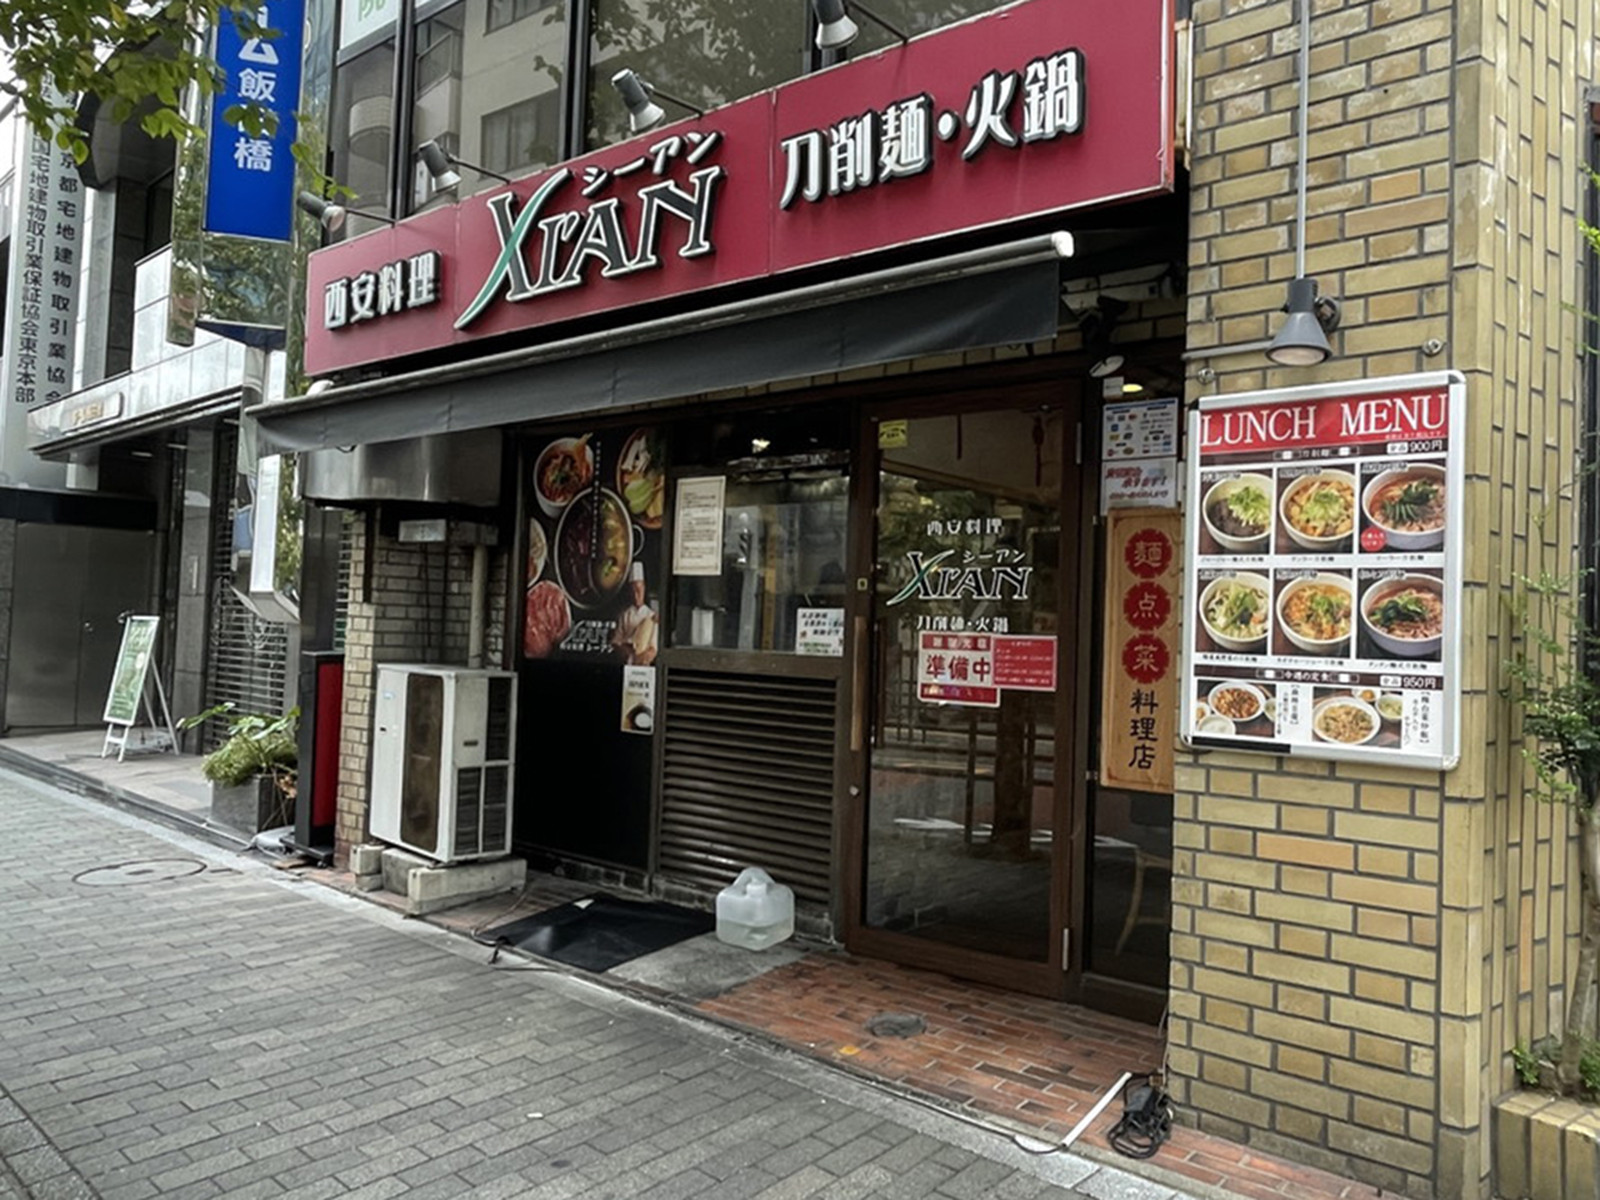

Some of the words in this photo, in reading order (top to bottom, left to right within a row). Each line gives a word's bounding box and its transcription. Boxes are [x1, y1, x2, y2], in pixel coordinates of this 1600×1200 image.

[582, 131, 720, 197] シーアン
[15, 125, 51, 404] 国宅地建物取引業保証協会東京本部
[325, 251, 438, 330] 西安料理
[1202, 405, 1317, 447] LUNCH
[1339, 393, 1448, 438] MENU
[1409, 440, 1443, 453] 900円
[962, 548, 1027, 564] シーアン
[925, 653, 991, 683] 準備中
[1402, 676, 1437, 689] 950円
